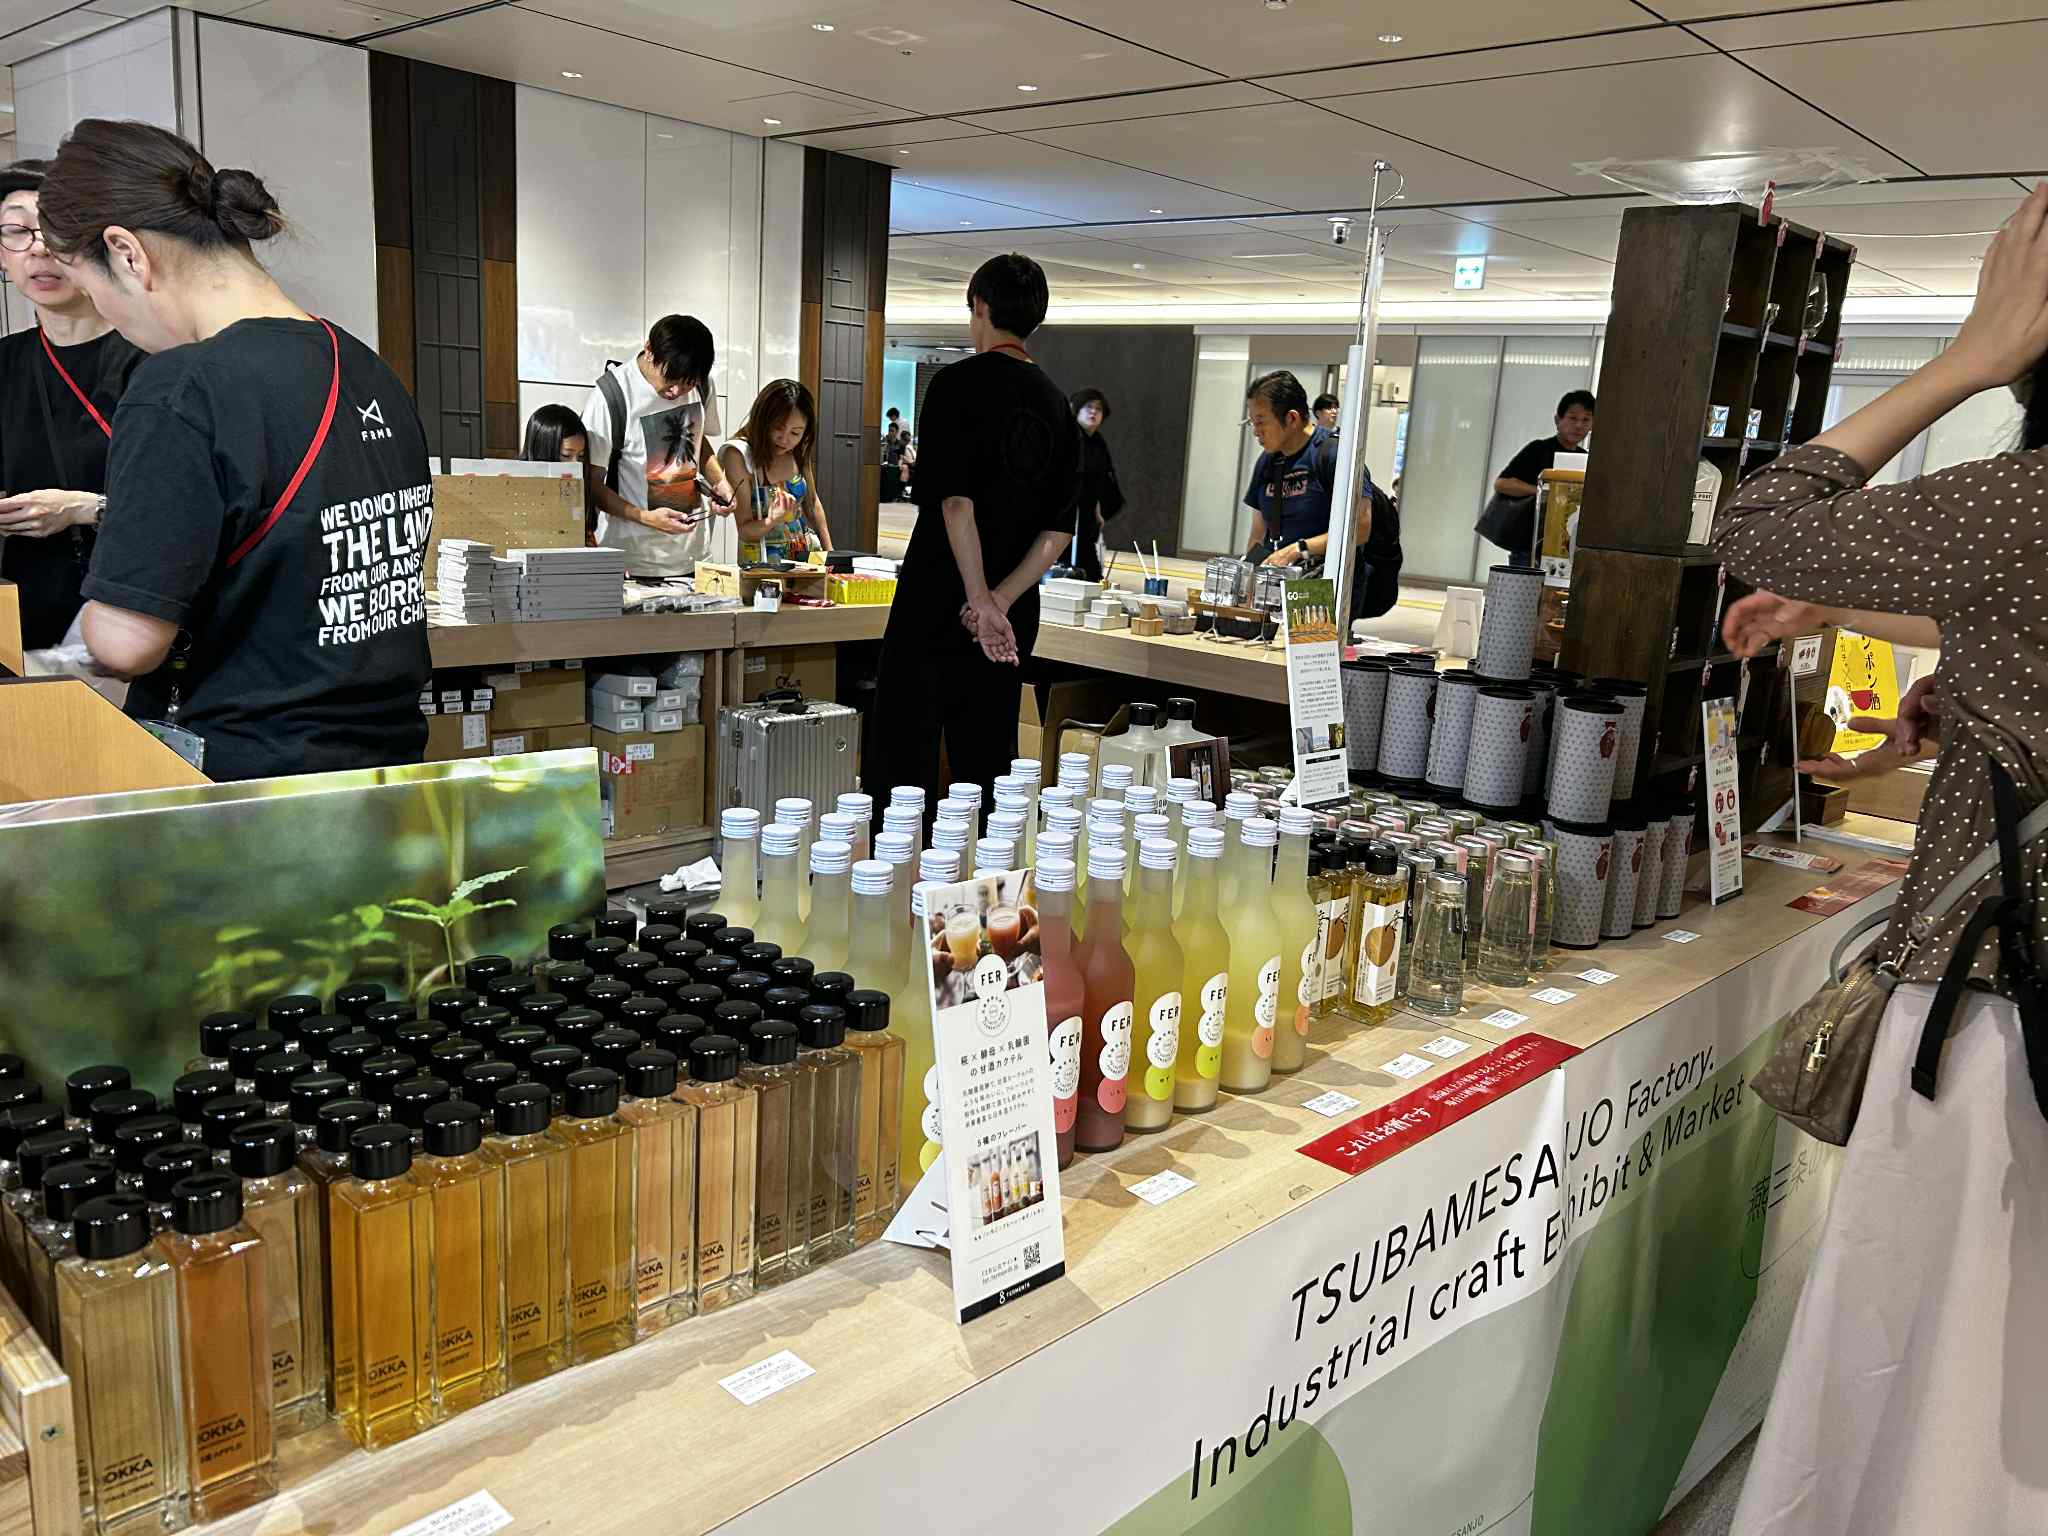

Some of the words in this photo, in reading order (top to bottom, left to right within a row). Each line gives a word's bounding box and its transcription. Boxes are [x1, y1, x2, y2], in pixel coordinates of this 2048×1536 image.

[320, 504, 349, 531] WE
[322, 521, 382, 573] THE
[387, 507, 433, 556] LAND
[320, 570, 367, 595] FROM
[370, 563, 389, 585] OUR
[318, 593, 365, 625] WE
[318, 621, 371, 646] FROM
[371, 610, 397, 634] OUR
[981, 970, 1001, 986] FER
[1060, 1032, 1080, 1048] FER
[1112, 1016, 1131, 1032] FER
[970, 1054, 1023, 1077] の甘酒カクテル
[1625, 1046, 1714, 1128] Factory.
[977, 1123, 1027, 1147] 5種のフレーバー
[1336, 1107, 1431, 1156] これはお酒です
[1191, 1286, 1414, 1500] Industrial
[1430, 1229, 1525, 1320] craft
[1639, 1130, 1653, 1177] &
[1661, 1073, 1745, 1157] Market
